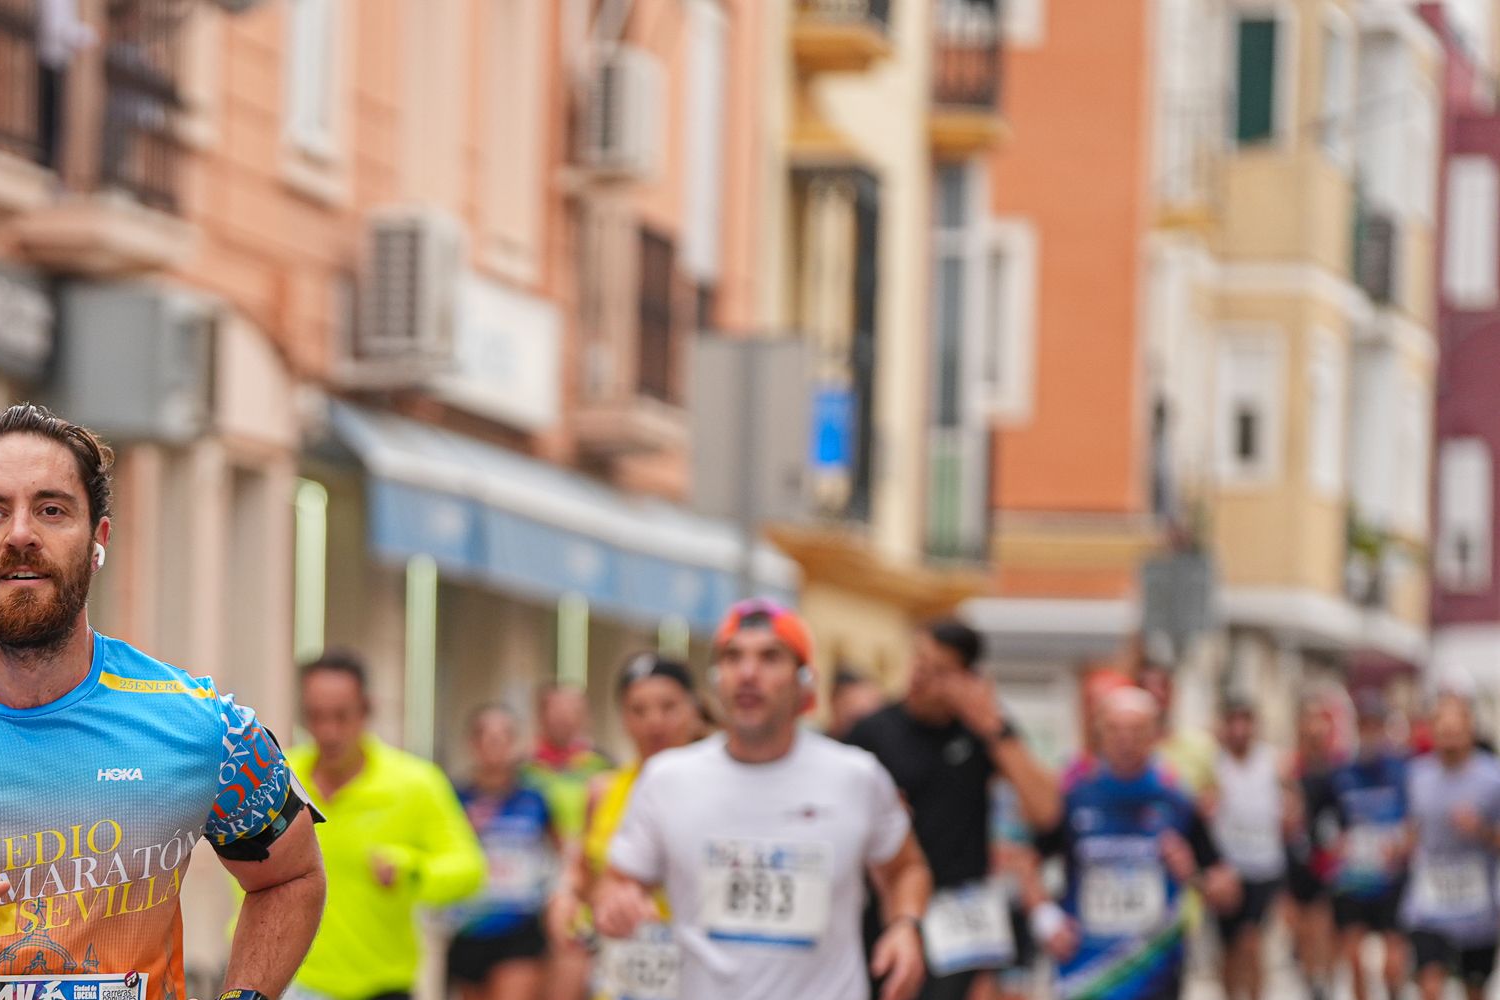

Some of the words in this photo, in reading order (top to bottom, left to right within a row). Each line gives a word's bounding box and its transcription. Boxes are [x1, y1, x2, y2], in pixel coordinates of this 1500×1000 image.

[97, 768, 143, 781] HOKA
[17, 867, 181, 935] SEVILLA
[73, 991, 97, 1000] LUCENA
[102, 989, 132, 997] carreras
